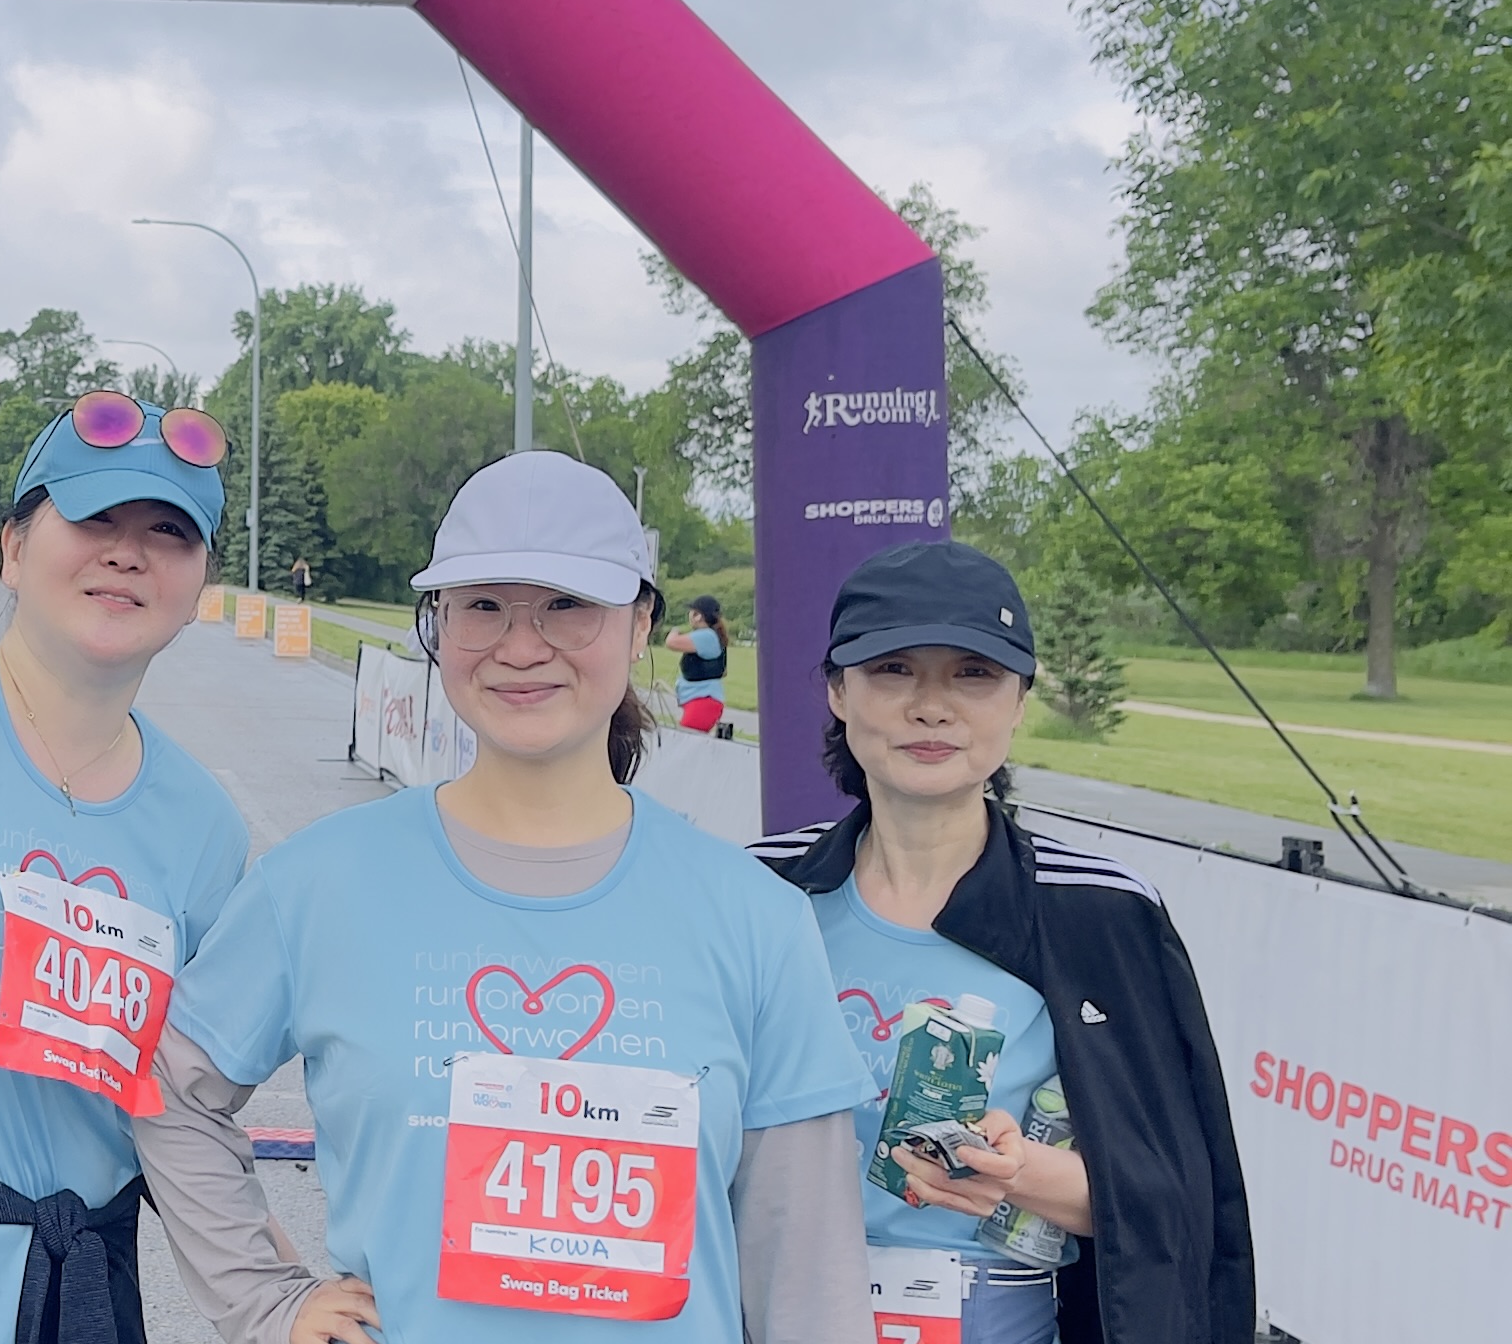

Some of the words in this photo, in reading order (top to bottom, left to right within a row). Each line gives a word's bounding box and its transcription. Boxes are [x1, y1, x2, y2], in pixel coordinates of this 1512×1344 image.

[823, 387, 927, 427] Running
[804, 498, 925, 520] SHOPPERS
[853, 514, 891, 525] DRUG
[893, 513, 924, 524] MART
[34, 936, 151, 1033] 4048
[43, 1049, 77, 1073] Swag
[1250, 1051, 1512, 1188] SHOPPERS
[484, 1140, 656, 1230] 4195
[1330, 1139, 1404, 1194] DRUG
[1412, 1170, 1512, 1230] MART
[529, 1234, 609, 1259] KOWA
[500, 1274, 544, 1296] Swag
[548, 1280, 579, 1301] Bag
[583, 1283, 629, 1302] Ticket
